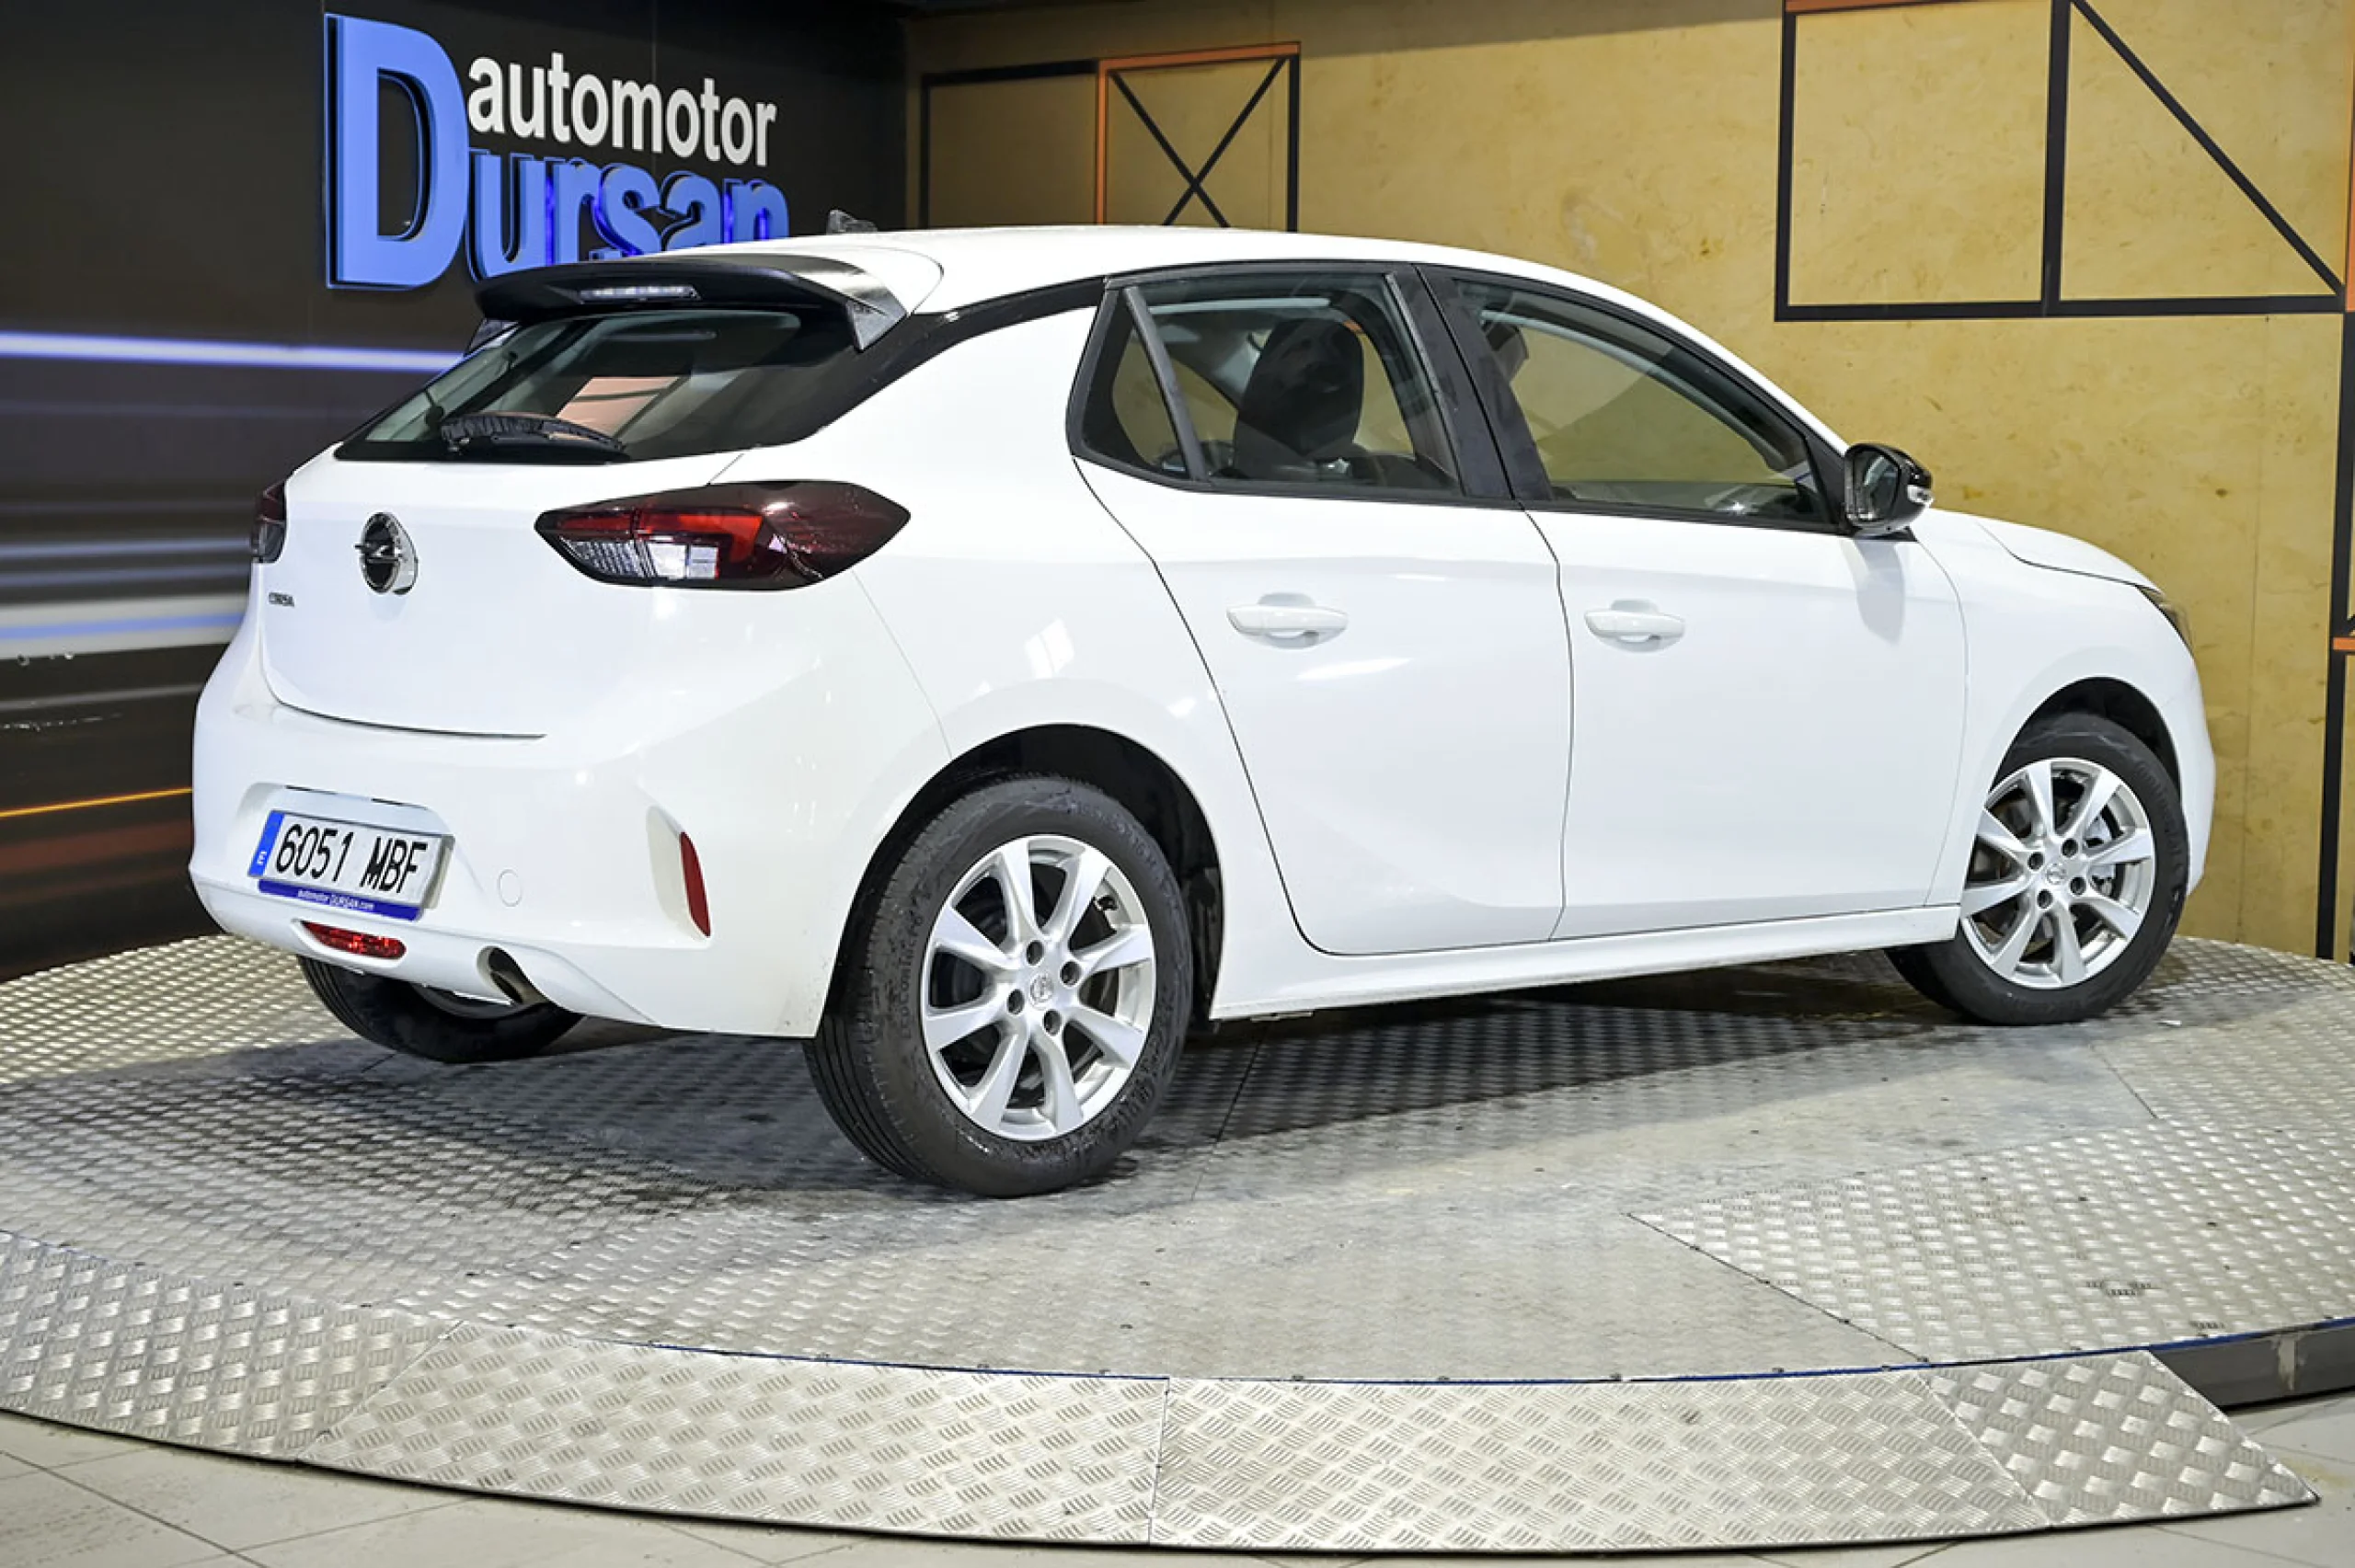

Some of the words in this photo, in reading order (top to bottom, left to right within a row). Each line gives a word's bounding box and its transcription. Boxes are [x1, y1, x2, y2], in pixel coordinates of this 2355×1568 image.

[326, 13, 789, 290] Dursan
[468, 52, 777, 166] automotor
[257, 850, 268, 866] E
[275, 823, 355, 882] 6051
[360, 835, 429, 894] MBF
